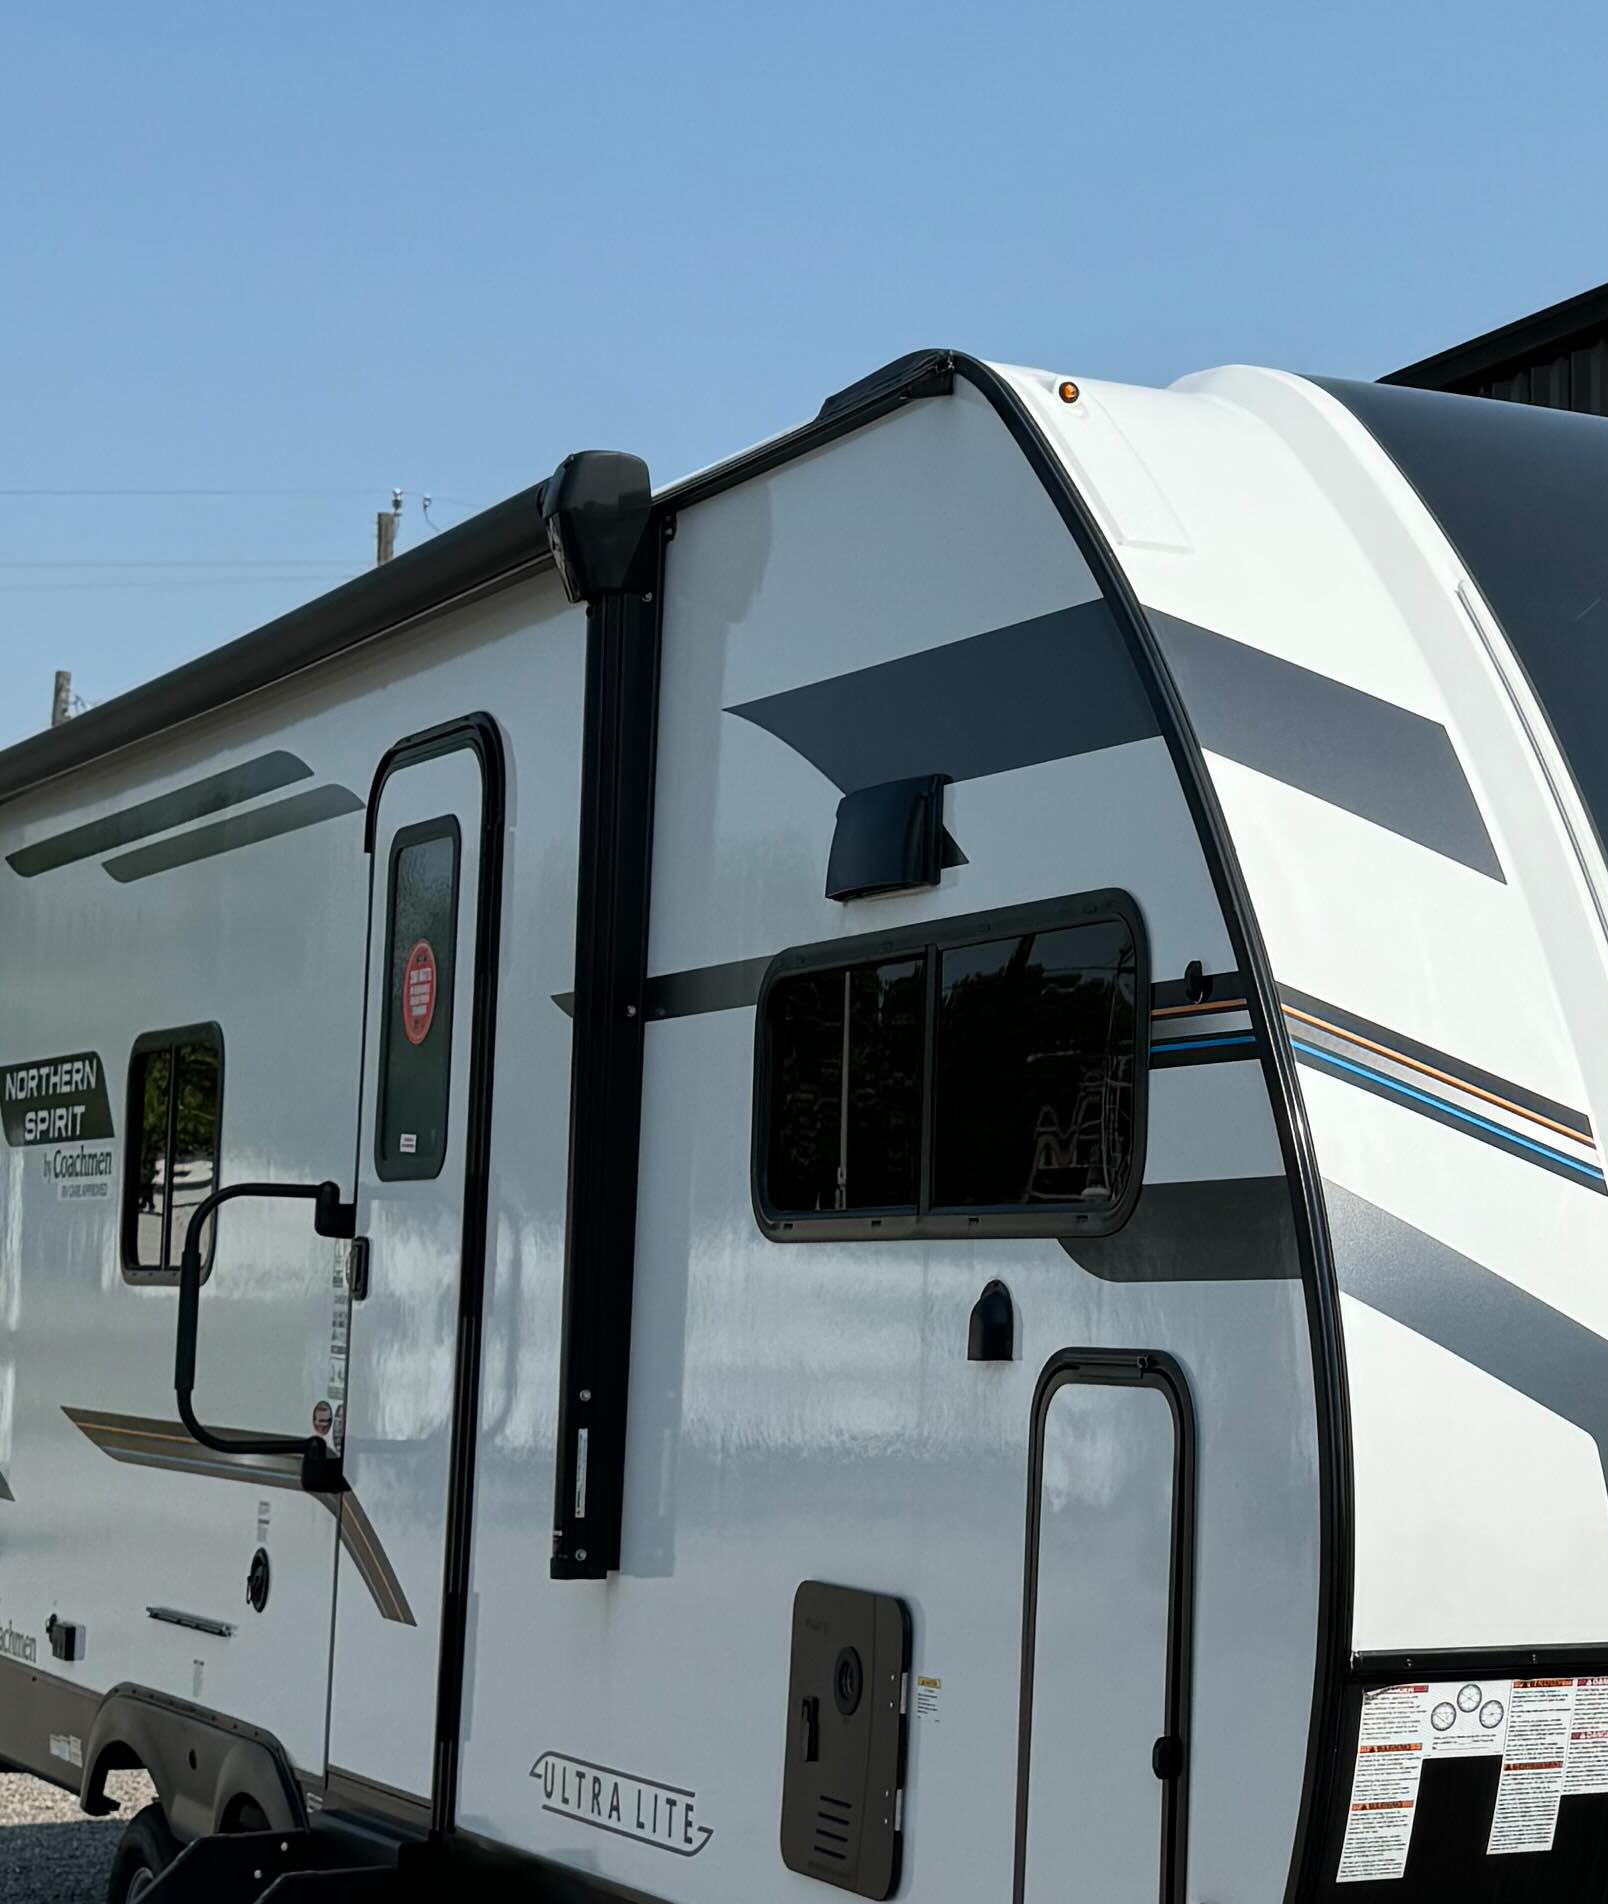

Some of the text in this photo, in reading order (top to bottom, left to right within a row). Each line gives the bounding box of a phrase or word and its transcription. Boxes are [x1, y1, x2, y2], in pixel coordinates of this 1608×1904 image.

[5, 1058, 97, 1101] NORTHERN
[24, 1105, 85, 1141] SPIRIT
[53, 1144, 112, 1179] Coachmen
[544, 1760, 694, 1844] ULTRA LITE
